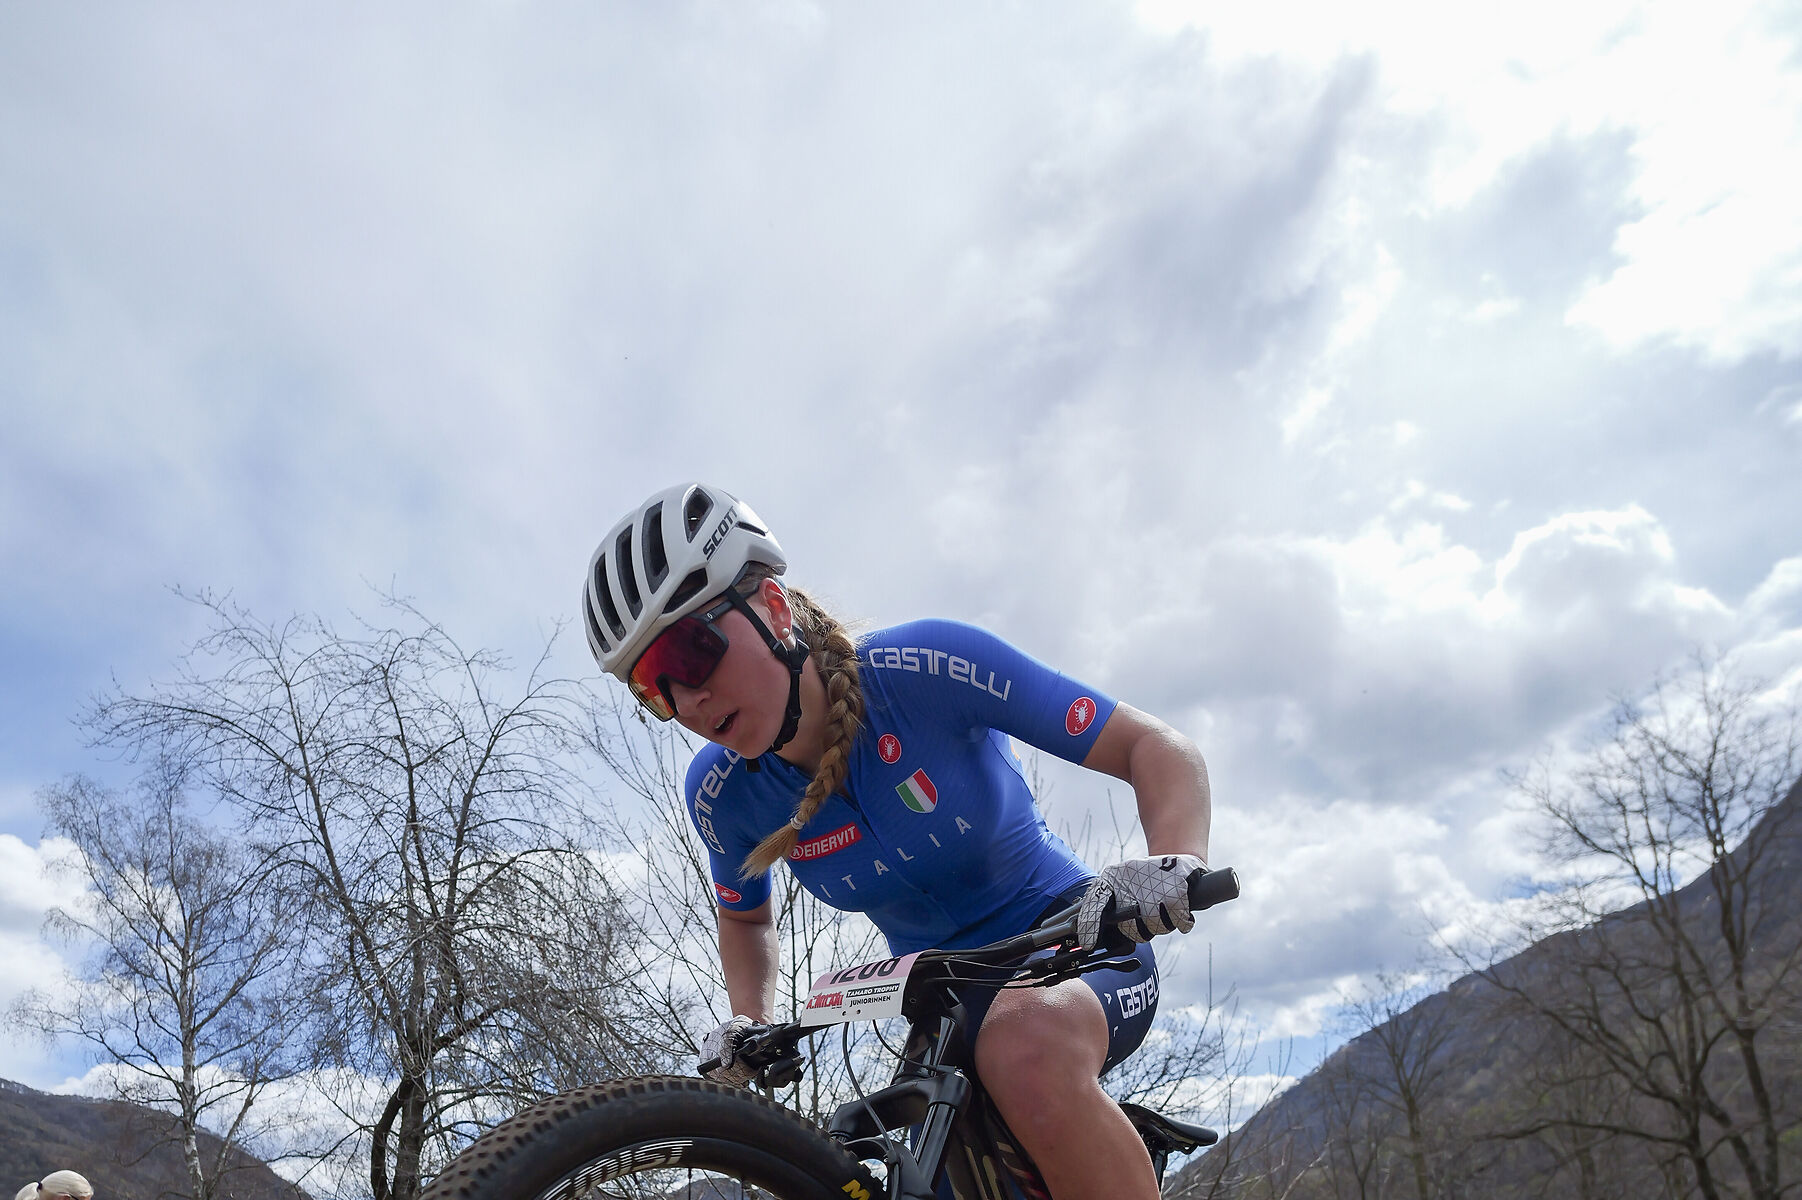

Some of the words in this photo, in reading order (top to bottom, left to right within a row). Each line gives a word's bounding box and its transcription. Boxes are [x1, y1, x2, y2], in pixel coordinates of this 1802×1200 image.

[703, 505, 737, 560] SCOTT
[804, 825, 856, 857] ENERVIT
[820, 816, 973, 899] ITALIA
[847, 988, 873, 997] TAMARO
[873, 985, 899, 994] TROPHY
[850, 995, 891, 1008] JUNIORINNEN
